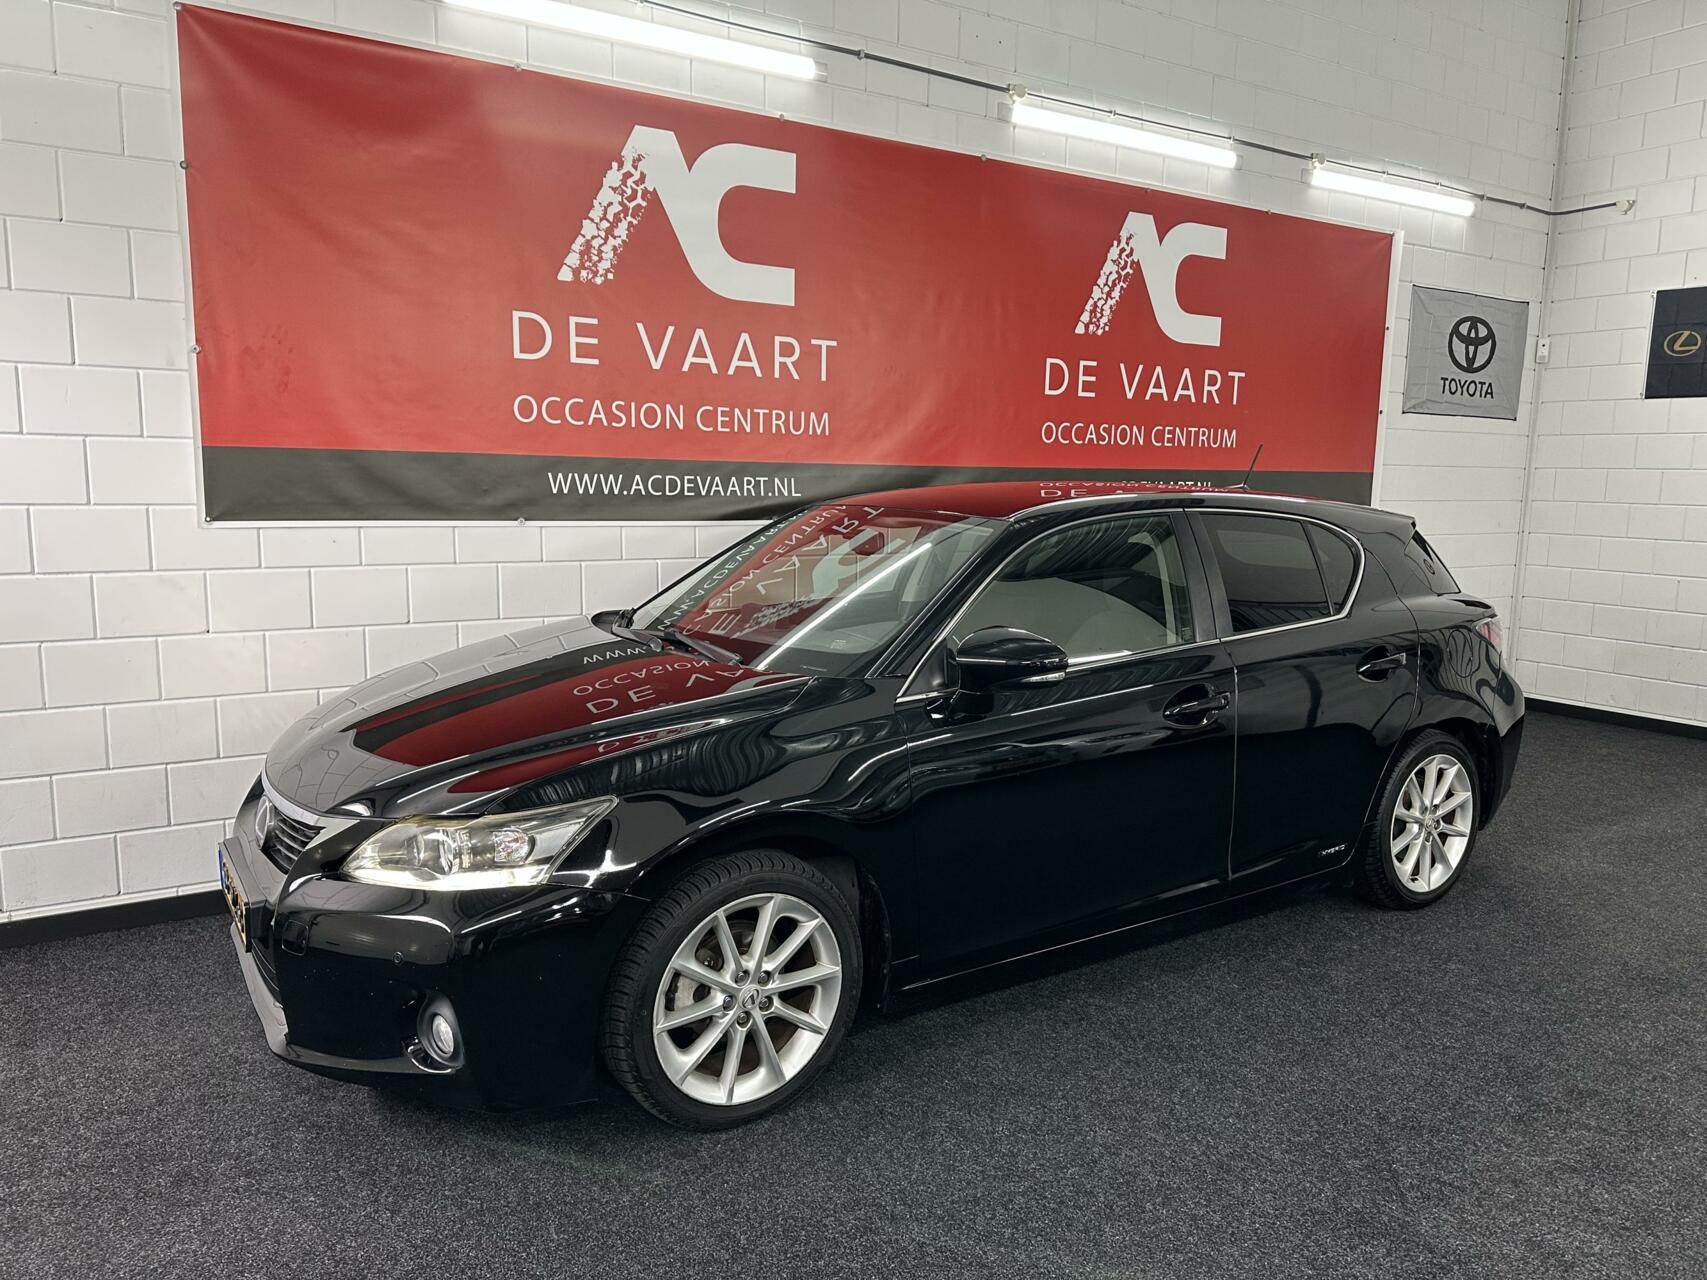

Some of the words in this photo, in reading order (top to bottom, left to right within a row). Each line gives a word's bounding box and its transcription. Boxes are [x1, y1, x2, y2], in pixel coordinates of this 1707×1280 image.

[511, 309, 600, 366] DE
[636, 322, 839, 382] VAART
[1044, 357, 1098, 398] DE
[1119, 363, 1246, 406] VAART
[1440, 376, 1495, 399] TOYOTA
[513, 394, 684, 430] OCCASION
[696, 405, 830, 436] CENTRUM
[1041, 421, 1145, 446] OCCASION
[1151, 425, 1237, 448] CENTRUM
[547, 472, 802, 498] WWW.ACDEVAART.NL
